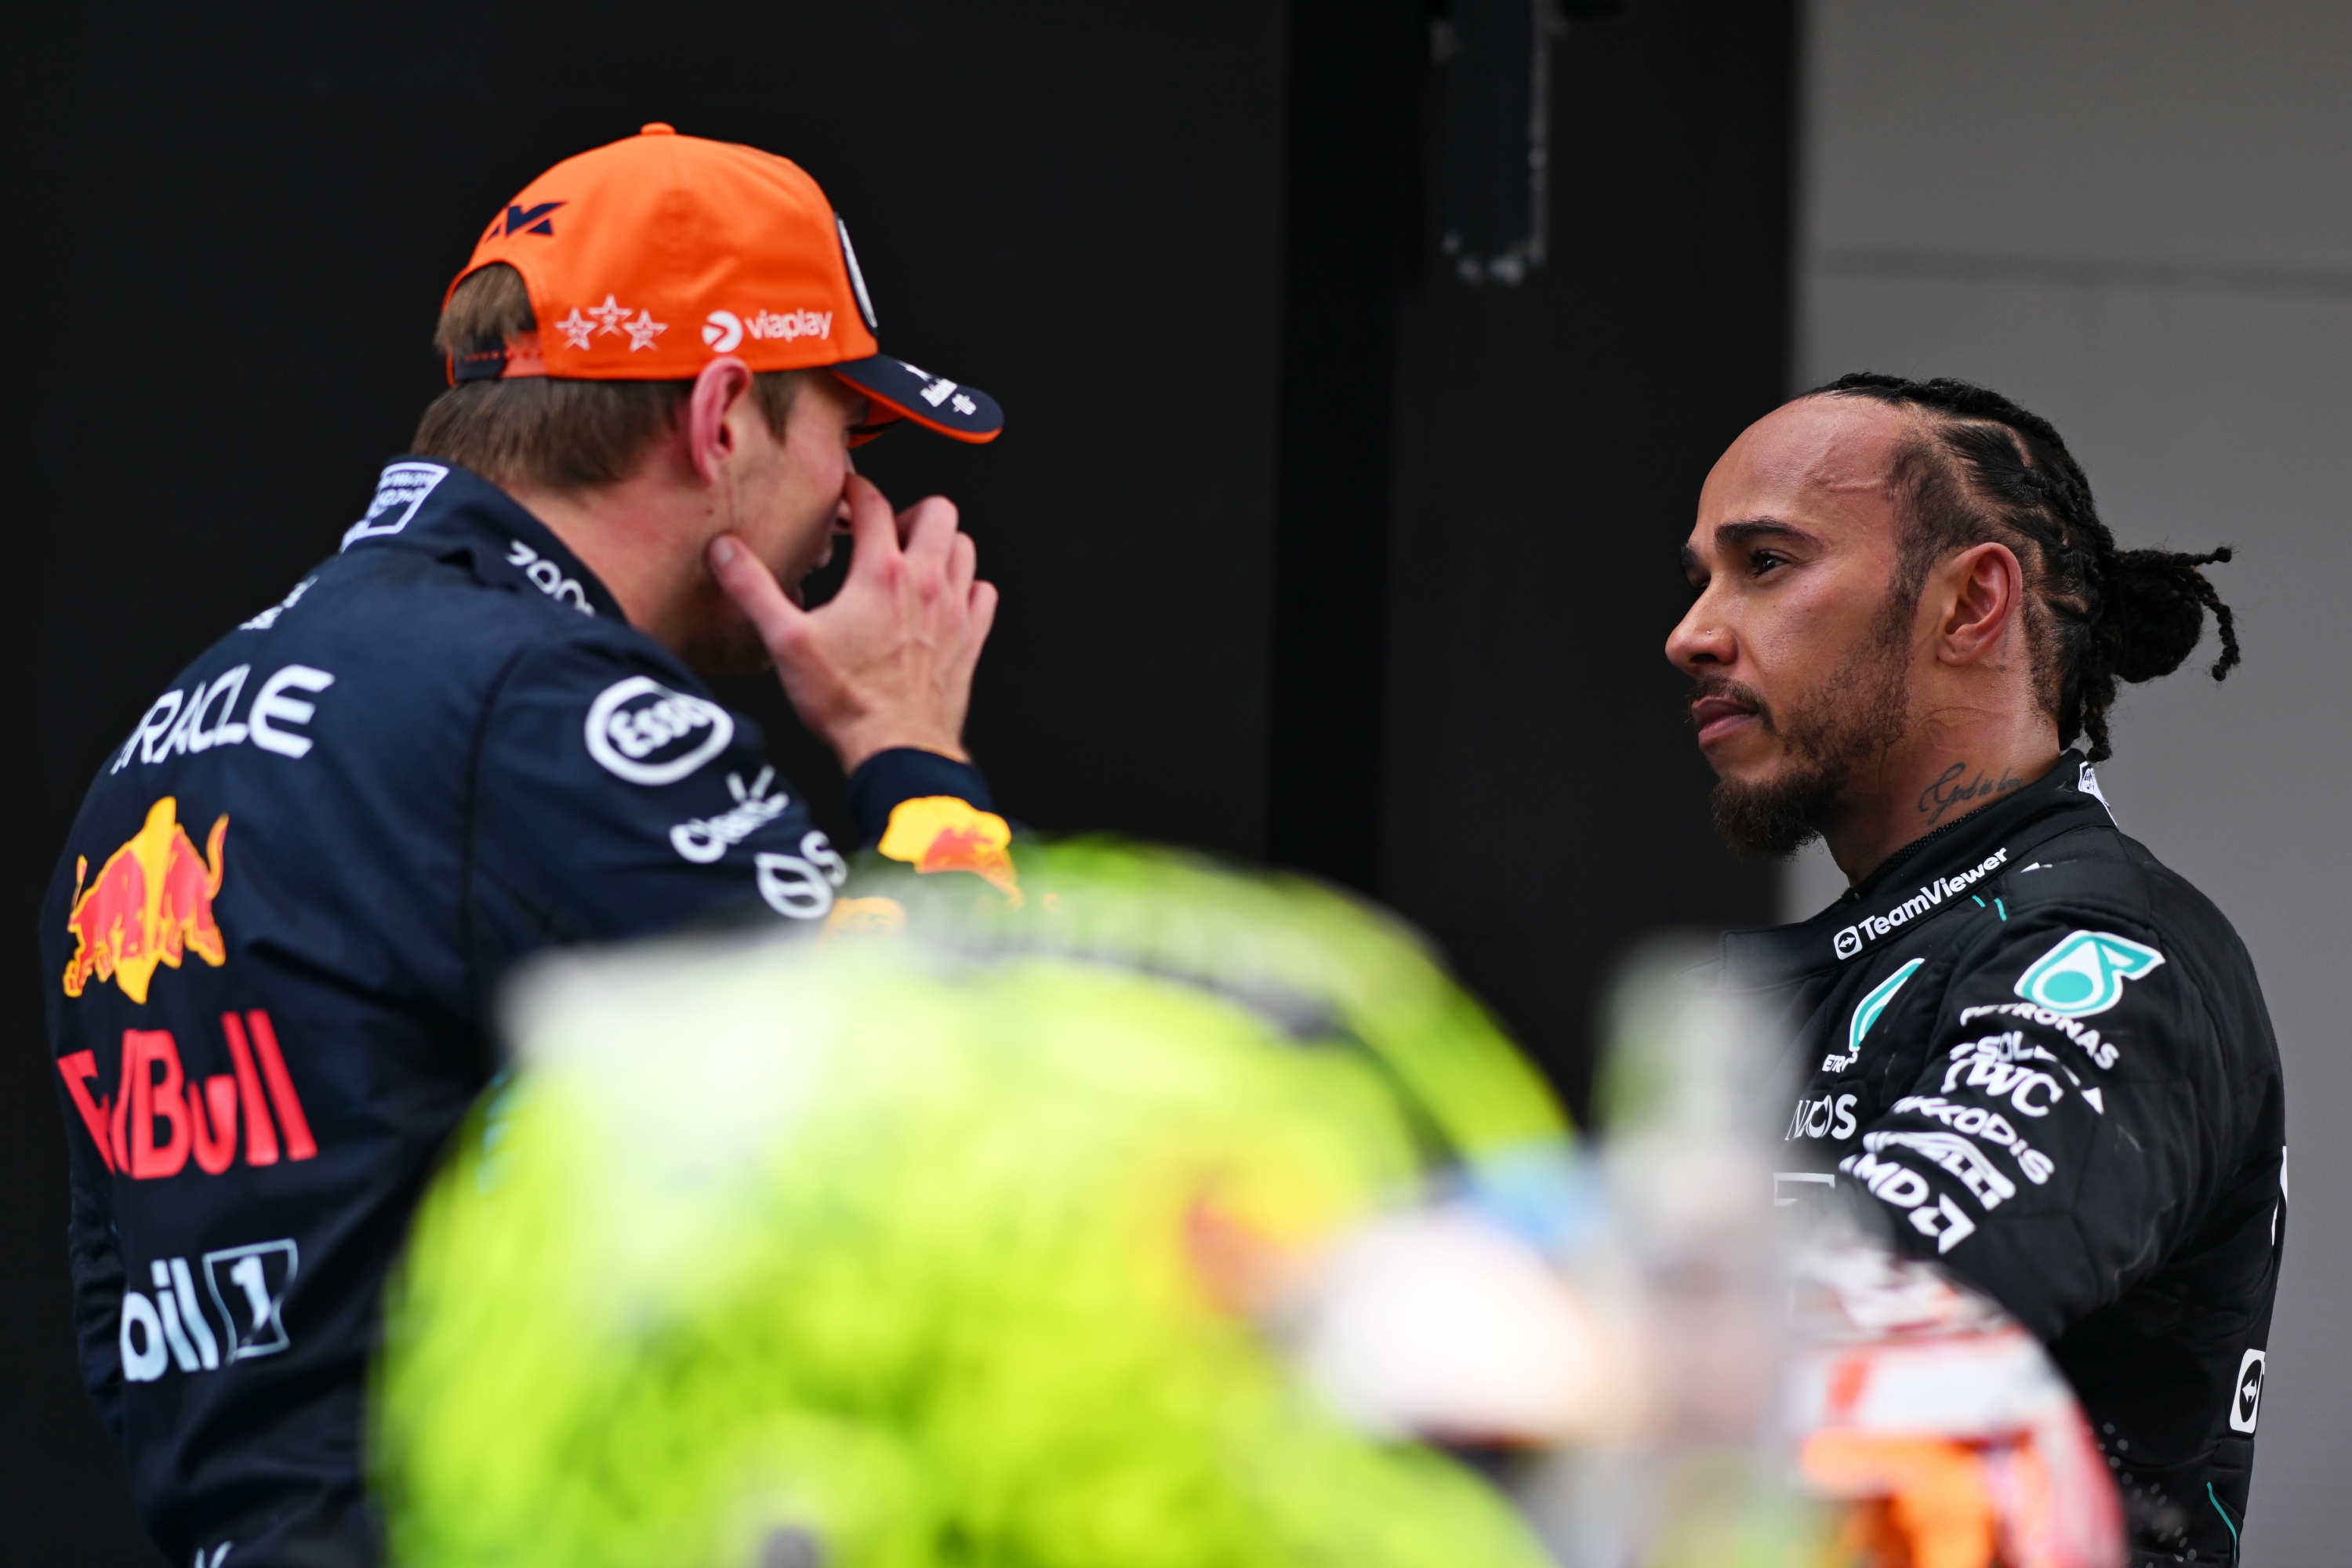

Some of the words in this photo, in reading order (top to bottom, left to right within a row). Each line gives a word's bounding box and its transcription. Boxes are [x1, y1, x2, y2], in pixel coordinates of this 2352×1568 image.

[744, 307, 833, 343] viaplay
[506, 538, 596, 618] ZOO
[110, 663, 336, 775] RACLE
[1858, 847, 2007, 942] TeamViewer
